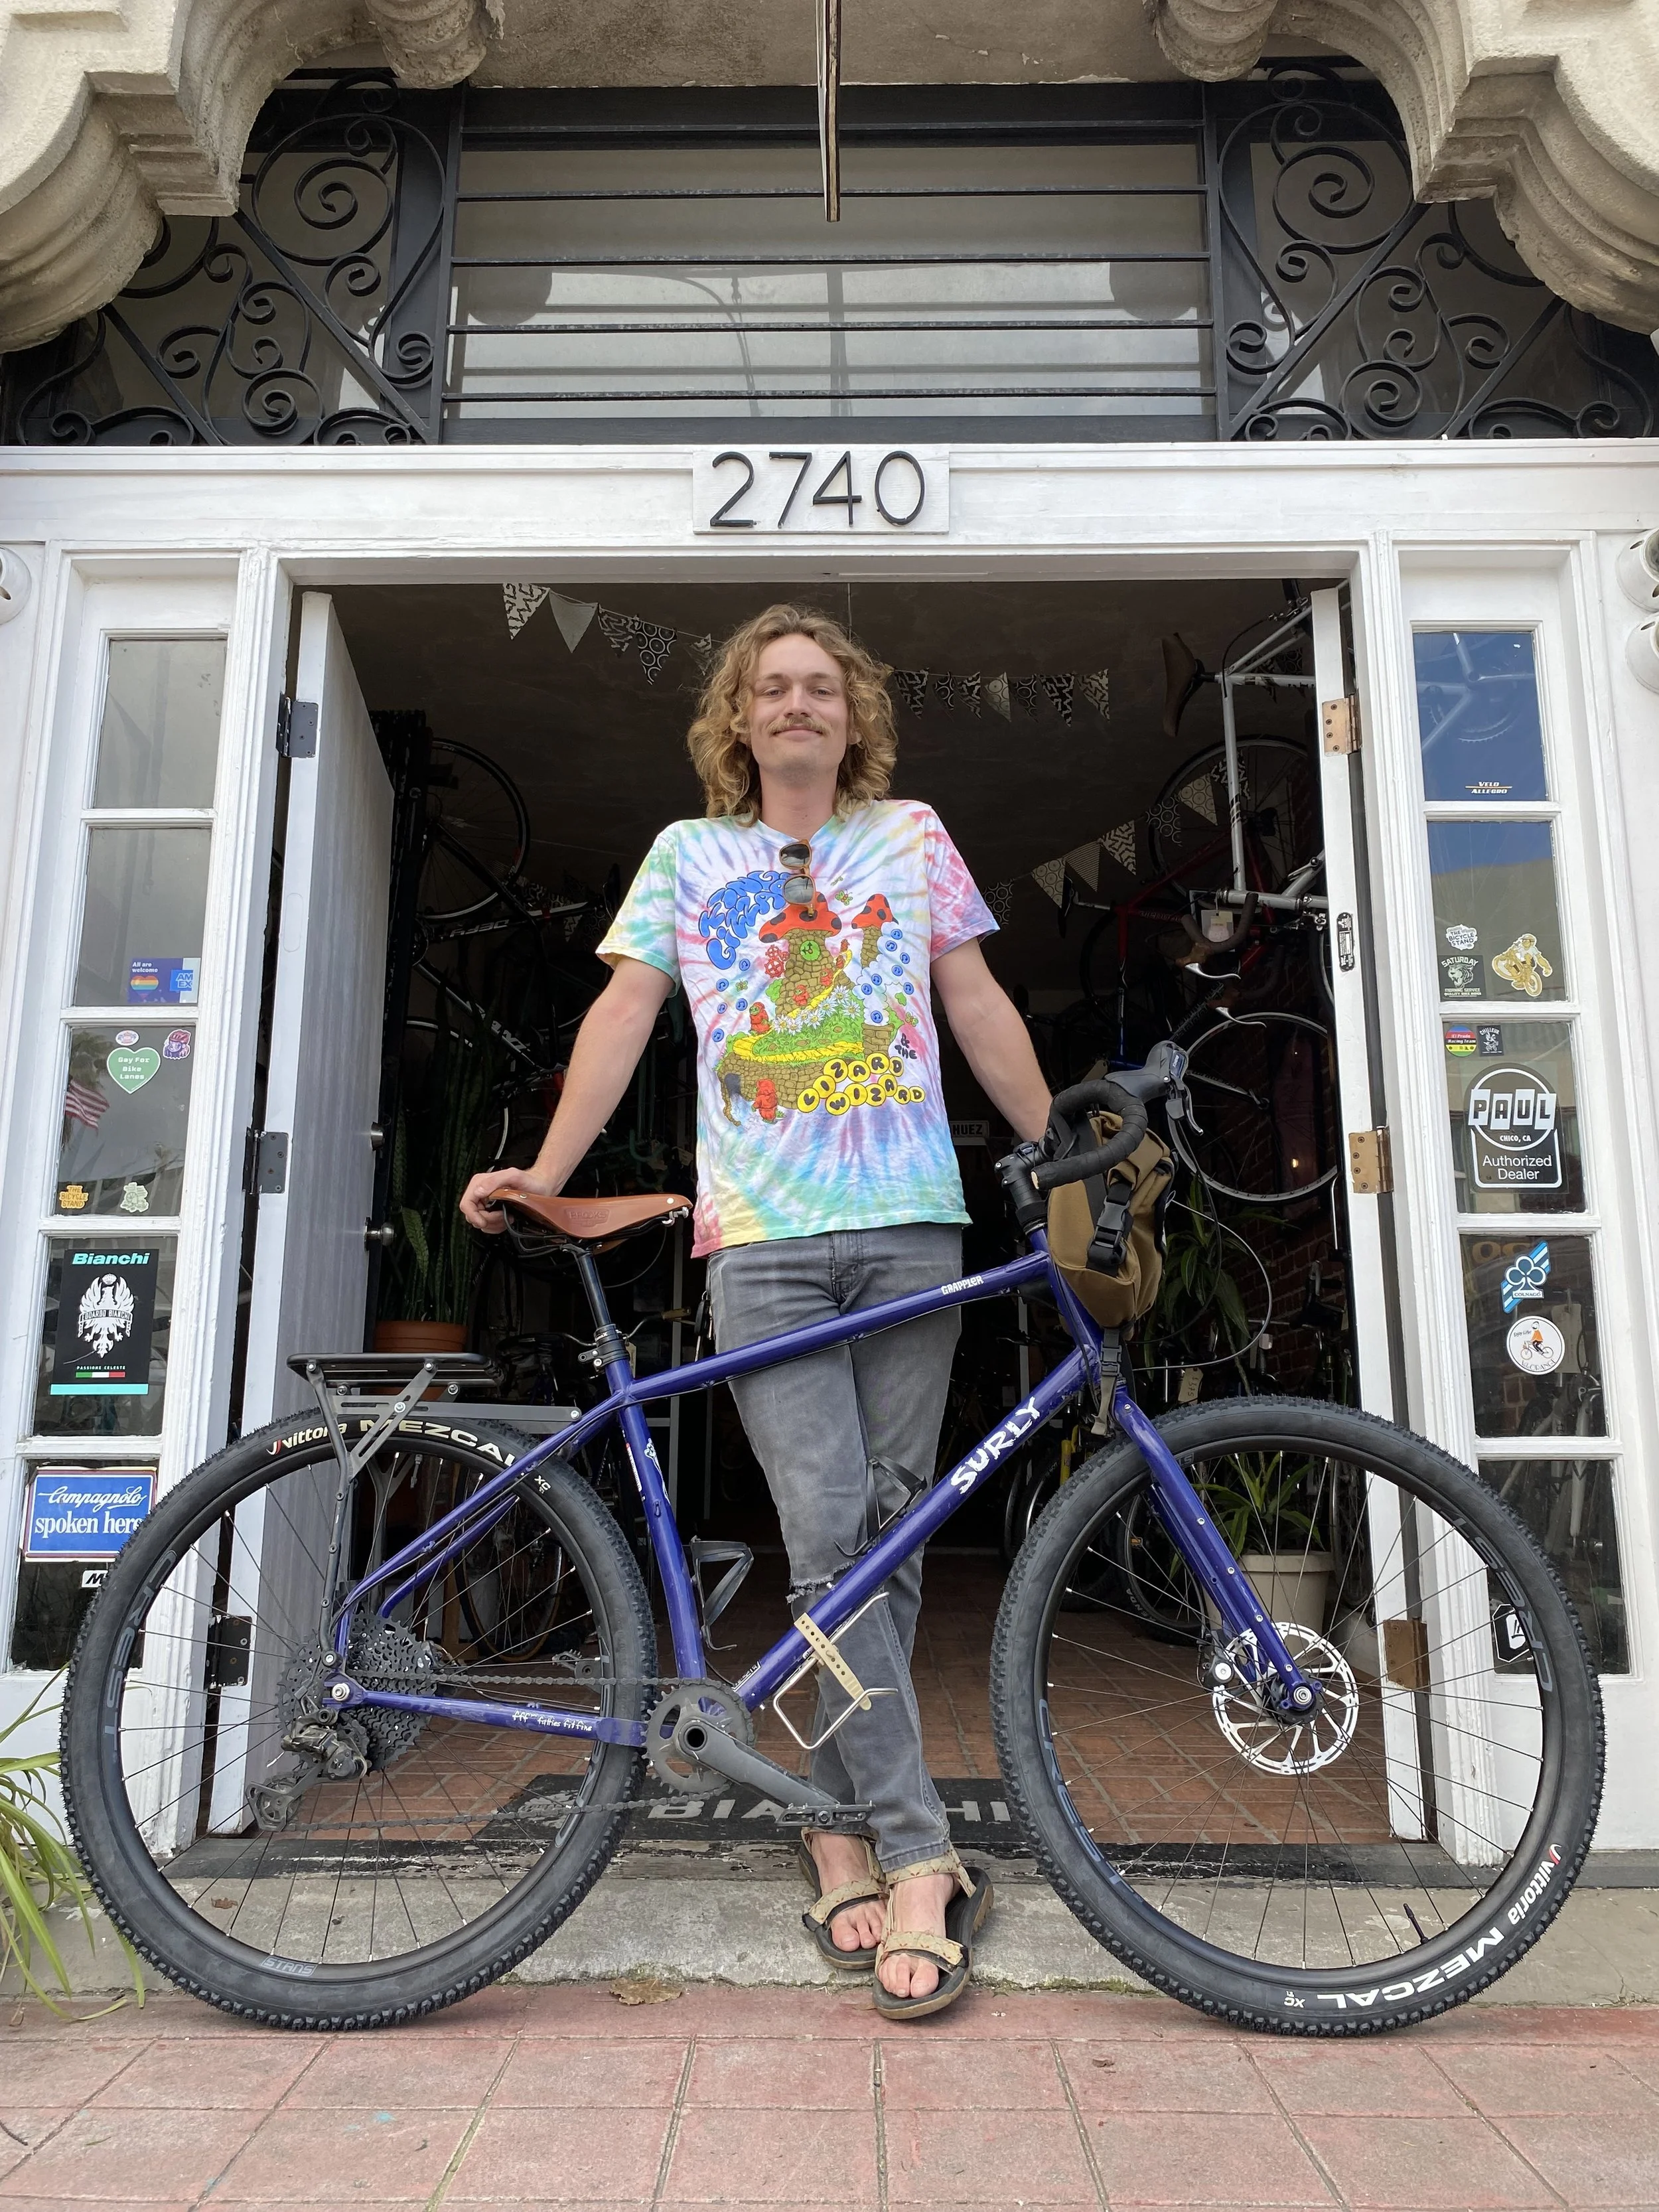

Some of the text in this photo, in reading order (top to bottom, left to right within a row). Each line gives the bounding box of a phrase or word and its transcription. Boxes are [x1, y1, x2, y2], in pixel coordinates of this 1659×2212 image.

[710, 451, 925, 528] 2740
[1451, 938, 1473, 946] STAND
[1441, 956, 1479, 968] SATURDAY
[1479, 1027, 1500, 1036] CHILLEUR
[895, 1045, 917, 1059] THE
[800, 1055, 903, 1109] LIZARD
[828, 1076, 923, 1112] WIZARD
[1471, 1094, 1553, 1125] PAUL
[952, 1124, 983, 1135] HUEZ
[1500, 1134, 1521, 1143] CHICO,
[1482, 1154, 1552, 1167] Authorized
[1498, 1168, 1540, 1180] Dealer
[72, 1252, 150, 1264] Bianchi
[941, 1275, 984, 1295] GRAPPLER
[82, 1309, 131, 1321] EDOARDO BIANCHI
[281, 1422, 347, 1449] vittora
[950, 1396, 1041, 1495] SURLY
[38, 1486, 147, 1513] Campagnolo
[35, 1511, 99, 1538] spoken
[538, 1716, 561, 1727] fatties
[563, 1718, 575, 1729] fit
[575, 1720, 593, 1732] fine
[648, 1798, 1011, 1822] BIAHI
[1317, 1860, 1554, 2010] vittoria MEZCAL
[264, 1956, 315, 1974] STANS
